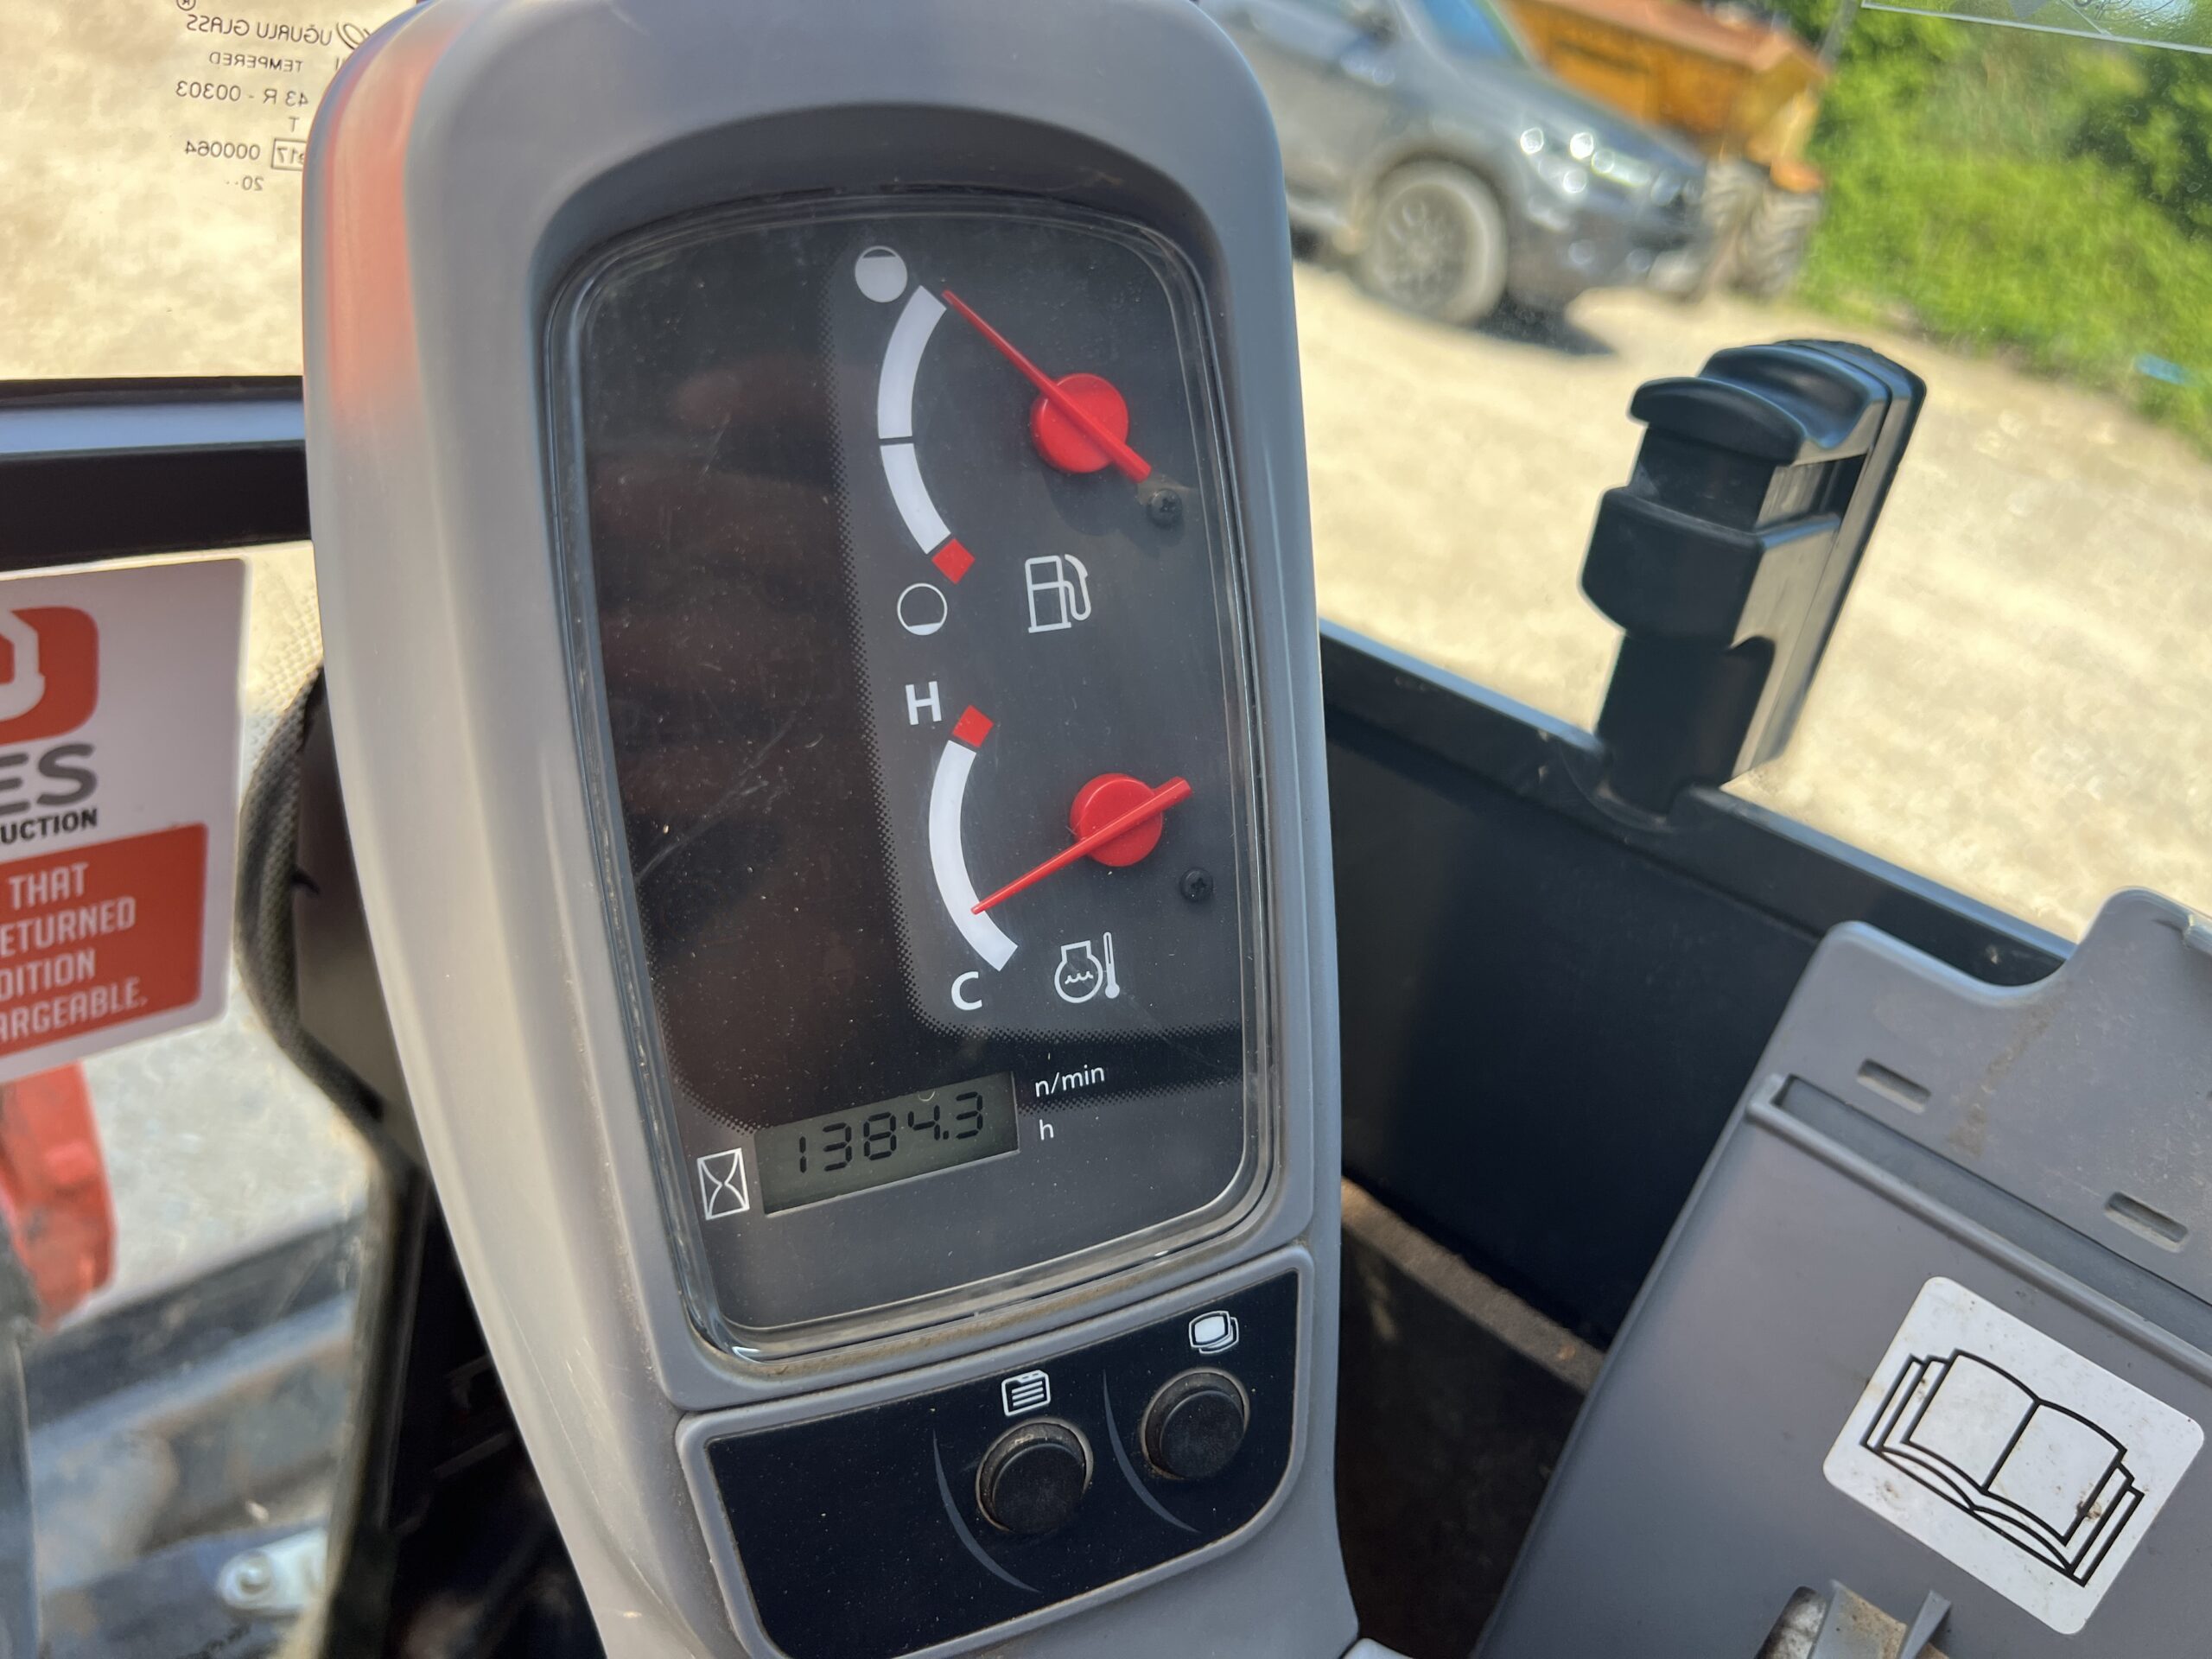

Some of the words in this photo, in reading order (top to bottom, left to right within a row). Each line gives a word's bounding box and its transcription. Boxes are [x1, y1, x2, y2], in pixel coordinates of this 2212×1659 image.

[904, 679, 943, 726] H
[7, 861, 90, 912] THAT
[950, 970, 983, 1011] C
[1034, 1064, 1106, 1098] n/min
[798, 1090, 984, 1174] 1384.3
[1039, 1118, 1055, 1141] h
